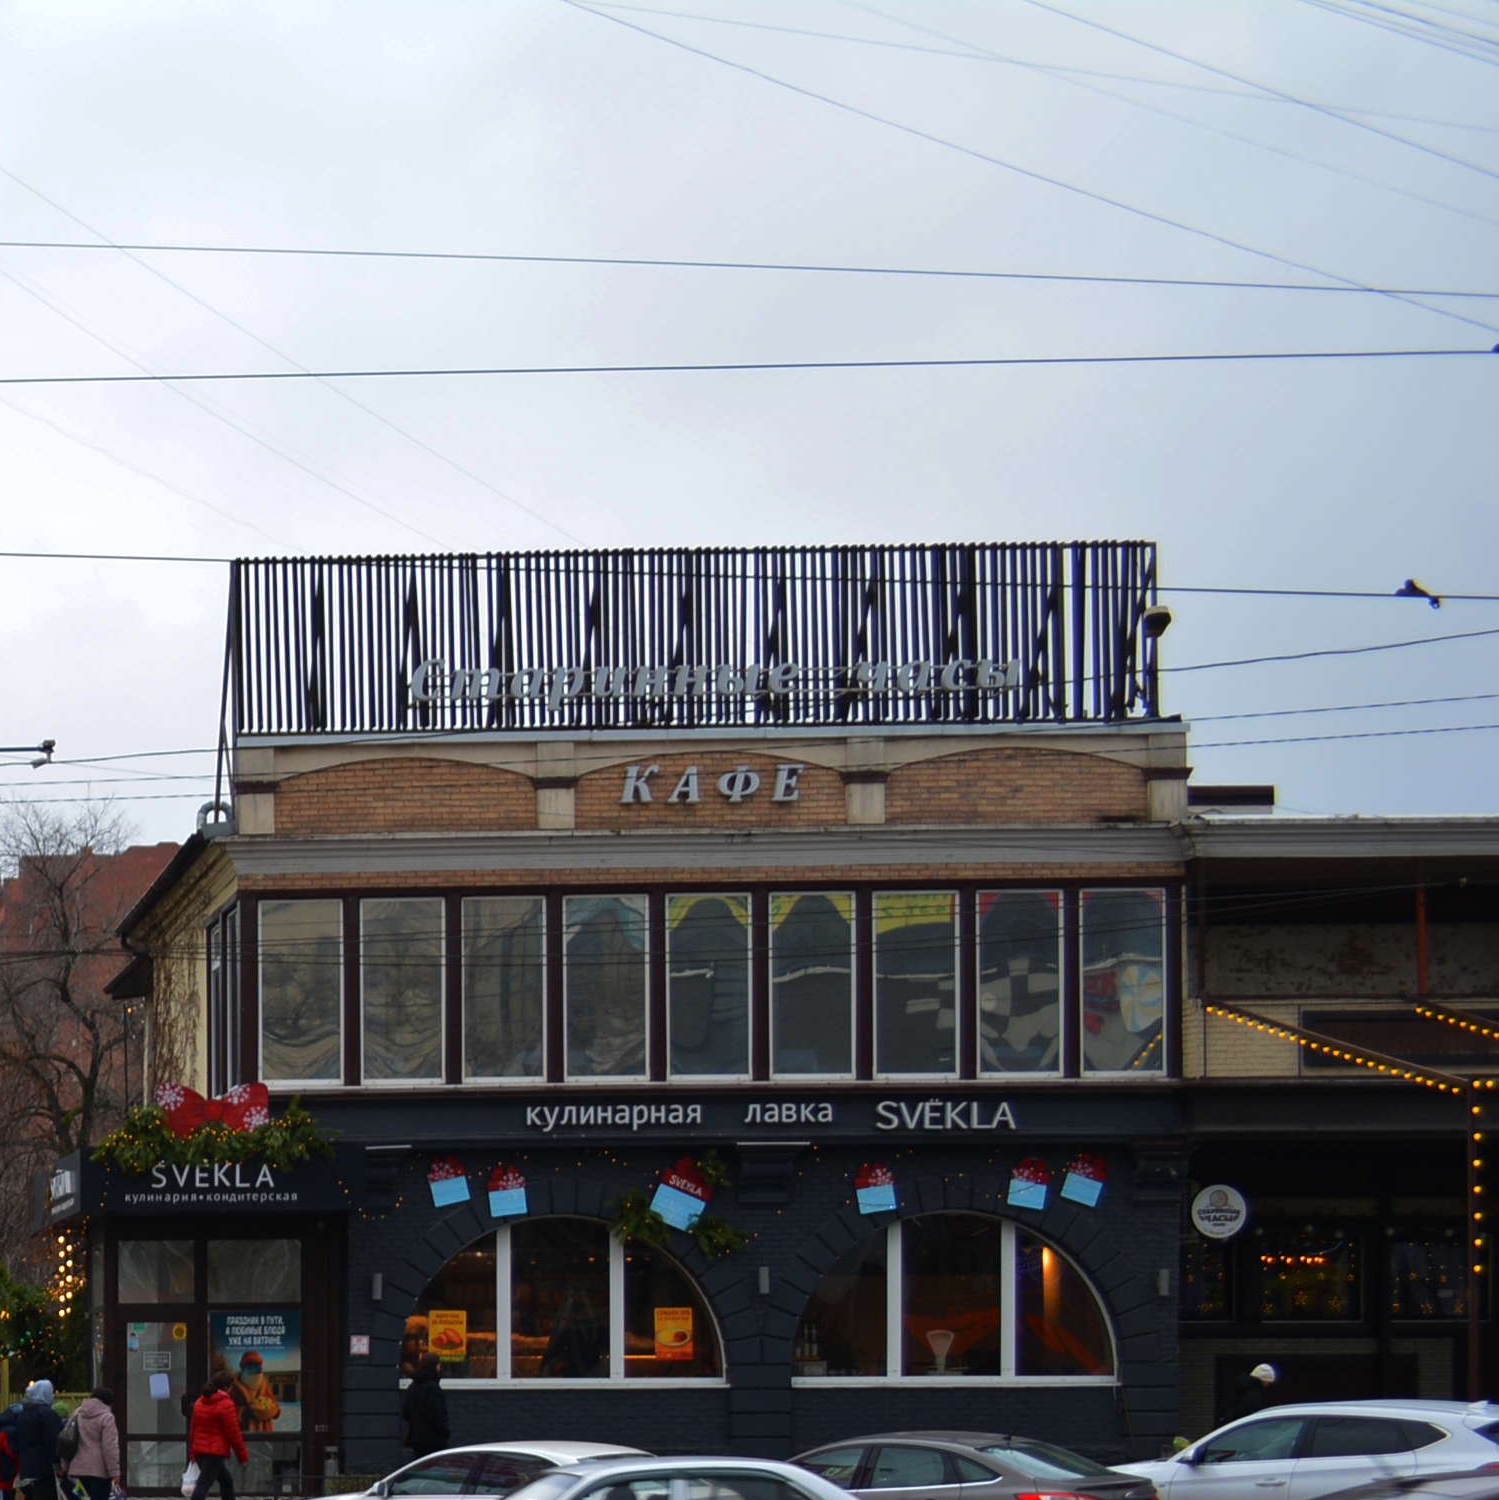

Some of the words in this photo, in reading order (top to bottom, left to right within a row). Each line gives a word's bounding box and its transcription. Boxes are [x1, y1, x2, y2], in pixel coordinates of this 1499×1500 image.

[411, 658, 799, 711] Старинные
[856, 658, 1021, 693] часы
[619, 763, 803, 804] КАФЕ
[526, 1104, 702, 1132] кулинарная
[744, 1102, 833, 1123] лавка
